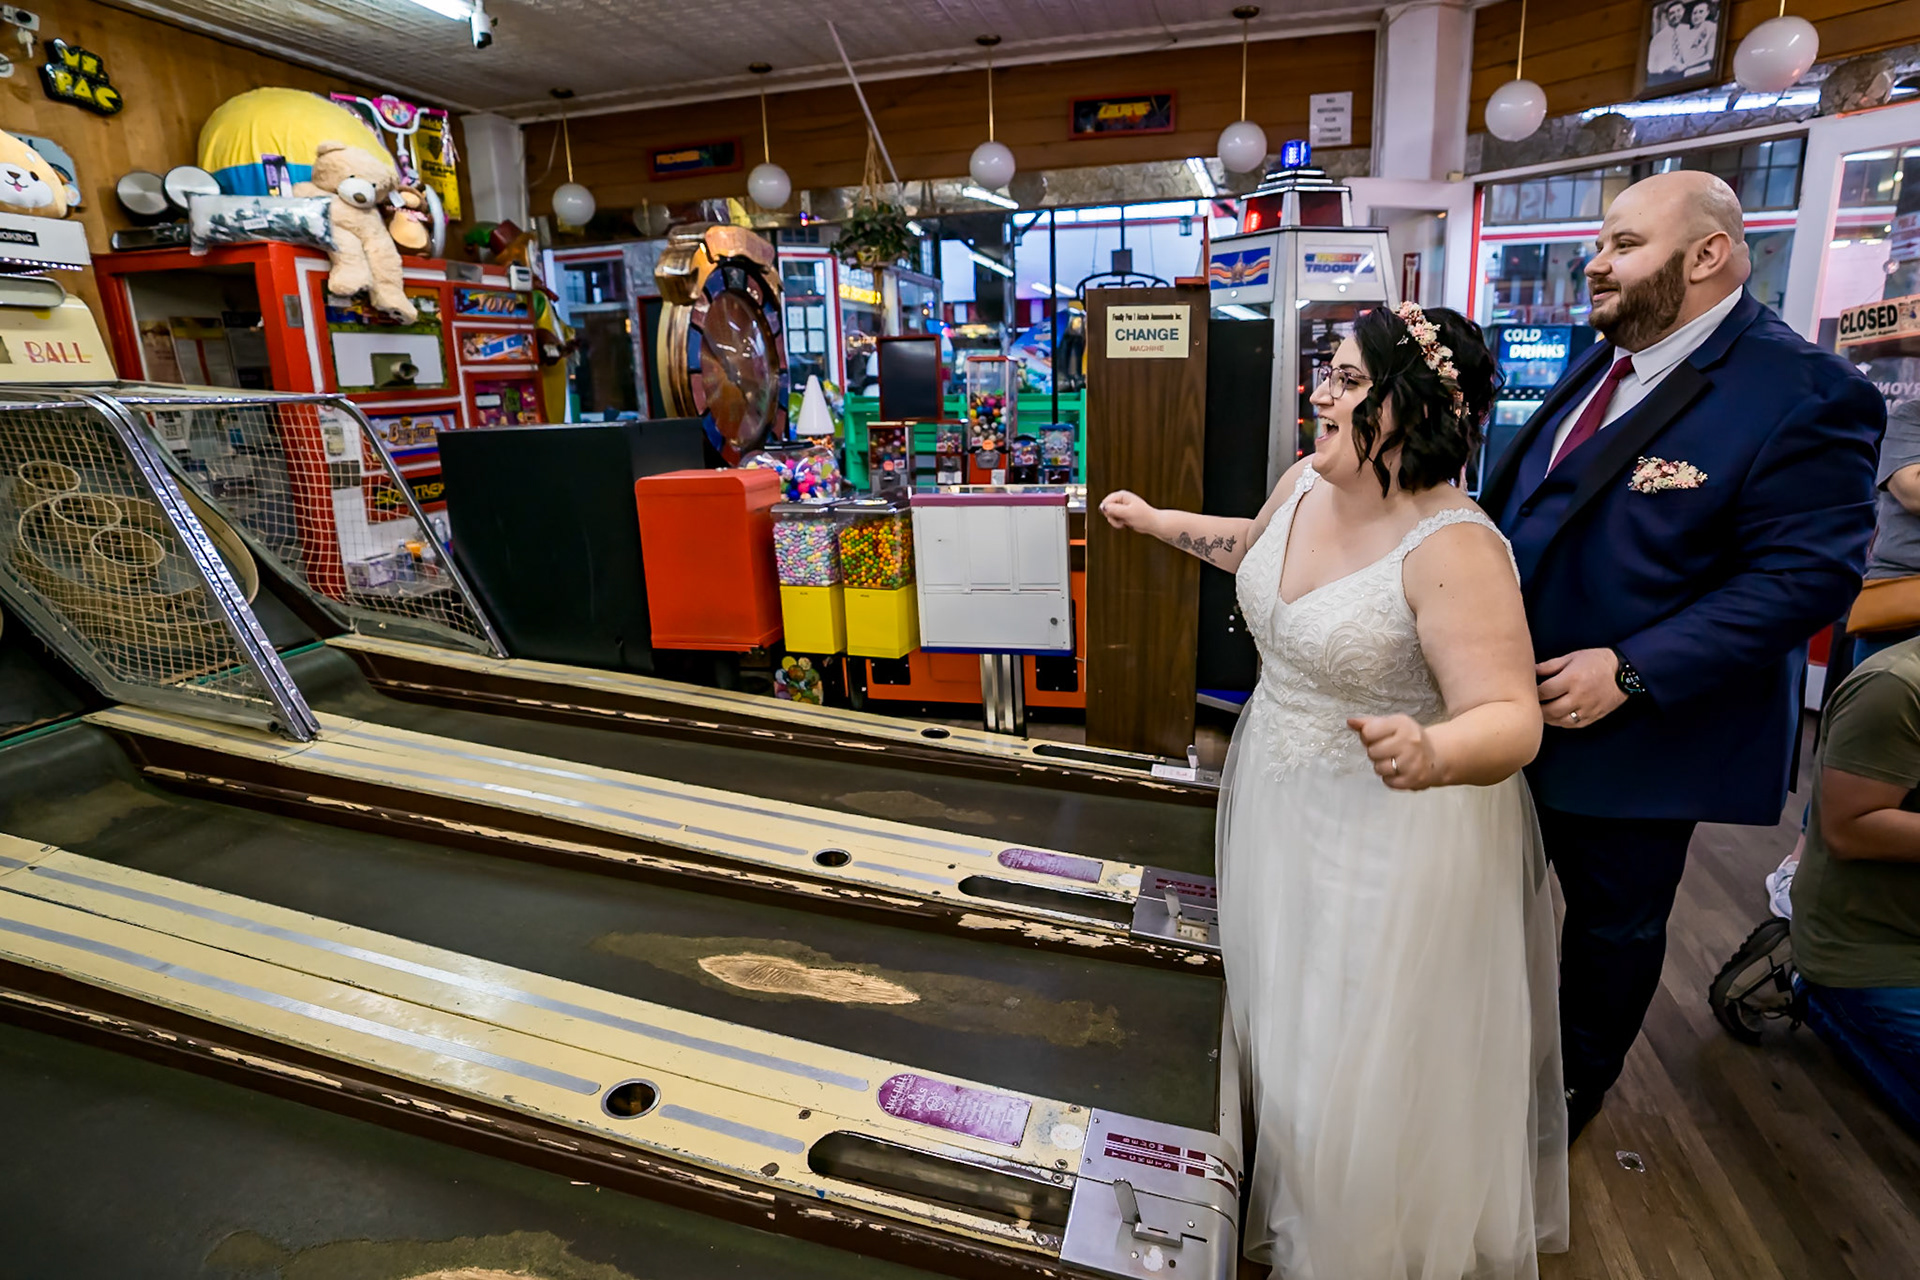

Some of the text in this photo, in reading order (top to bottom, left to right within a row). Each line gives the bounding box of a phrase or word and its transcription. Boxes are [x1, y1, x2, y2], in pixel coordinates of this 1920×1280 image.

[1840, 304, 1898, 335] CLOSED
[1115, 328, 1179, 341] CHANGE
[1503, 328, 1542, 342] COLD
[24, 341, 91, 363] BALL
[1509, 344, 1566, 359] DRINKS
